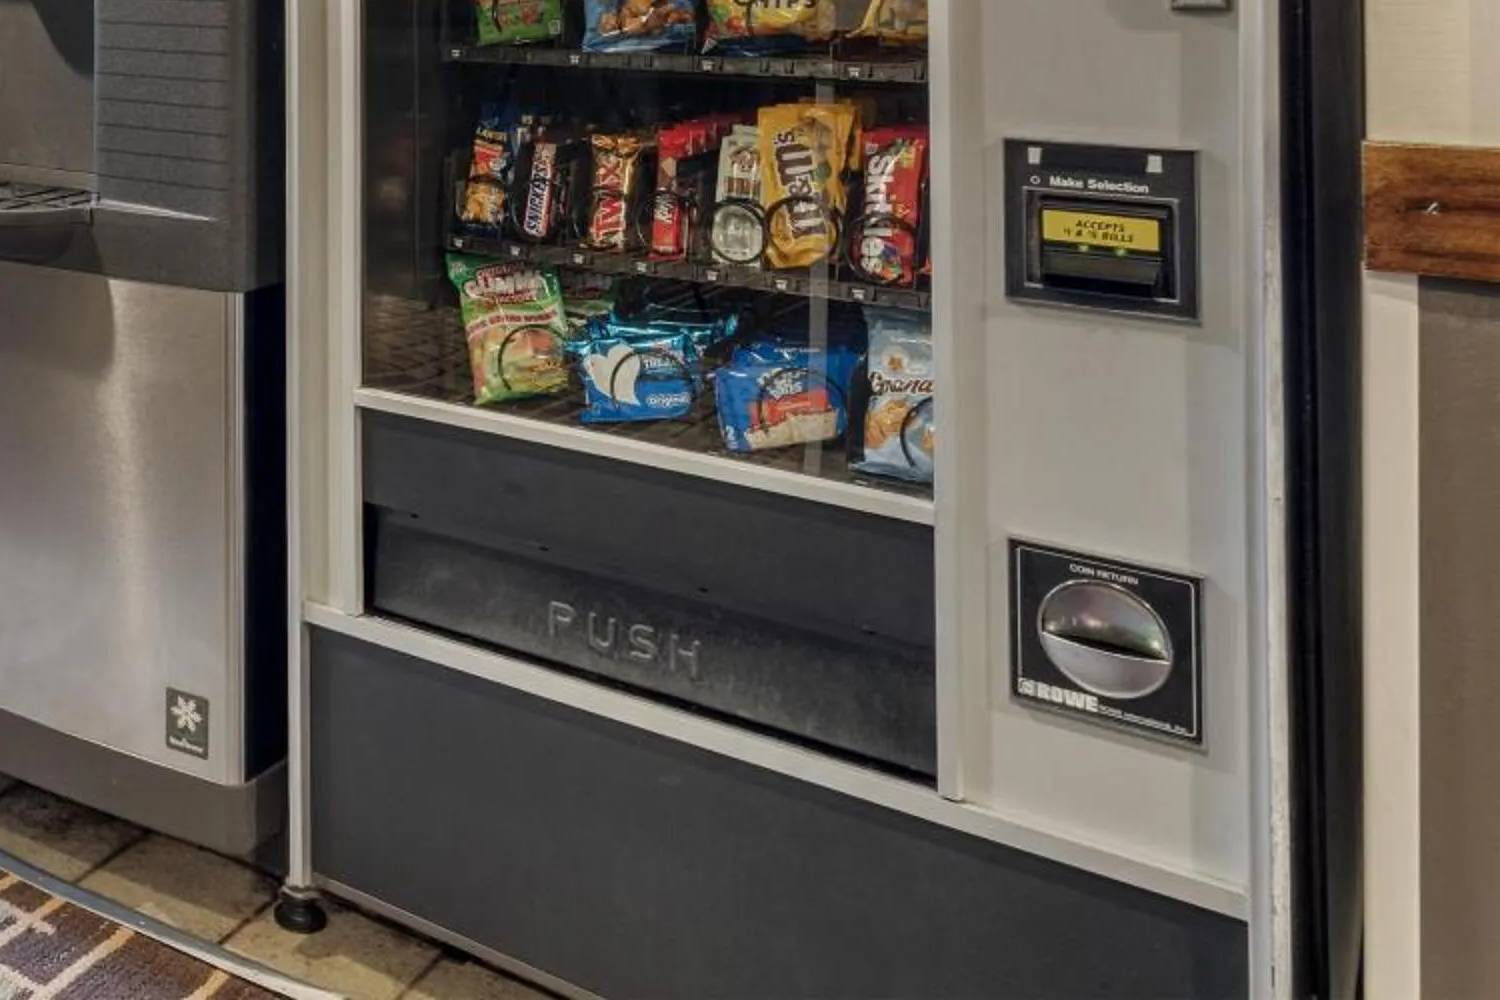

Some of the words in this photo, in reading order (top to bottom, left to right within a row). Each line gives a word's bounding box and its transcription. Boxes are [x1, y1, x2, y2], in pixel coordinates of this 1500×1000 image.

[525, 163, 552, 233] SNICKERS
[1049, 175, 1084, 189] Make
[1087, 178, 1149, 194] Selection
[1069, 563, 1095, 578] COIN
[548, 599, 701, 680] PUSH
[1036, 682, 1099, 712] ROWE
